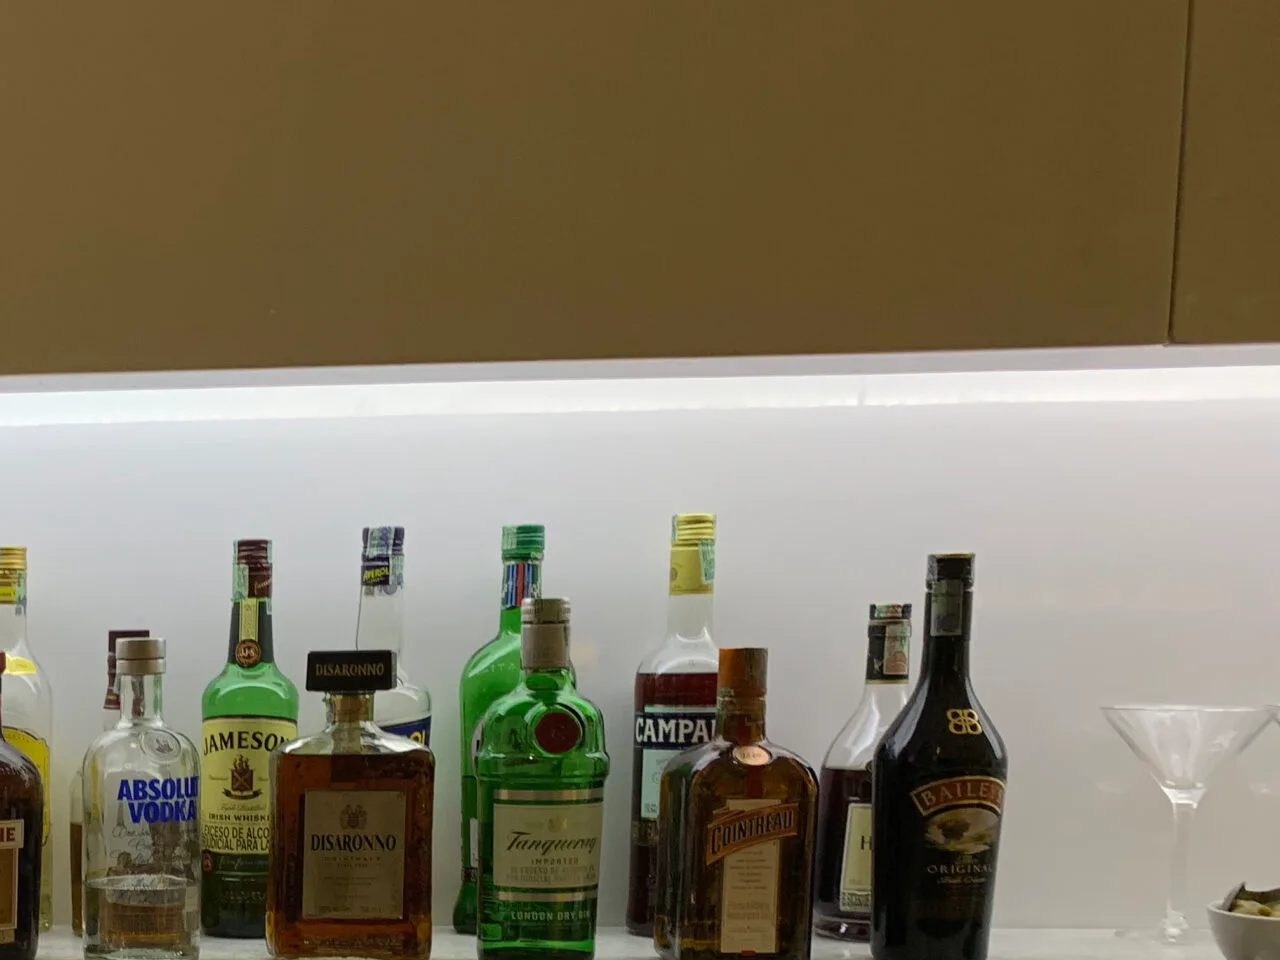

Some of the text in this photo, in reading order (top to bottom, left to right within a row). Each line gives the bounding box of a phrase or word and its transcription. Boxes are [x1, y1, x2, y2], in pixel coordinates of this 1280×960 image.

[315, 663, 385, 677] DISARONNO
[636, 717, 717, 744] CAMPA
[118, 776, 200, 801] ABSOLUT
[128, 800, 197, 824] VODKA
[209, 812, 231, 821] IRISH
[232, 827, 244, 839] DE
[246, 827, 270, 840] ALCO
[711, 810, 794, 854] COINTREAU
[236, 839, 258, 851] PARA
[311, 834, 396, 852] DISARONNO
[506, 831, 597, 856] Tanqueray
[511, 911, 553, 921] LONDON
[557, 911, 576, 921] DRY
